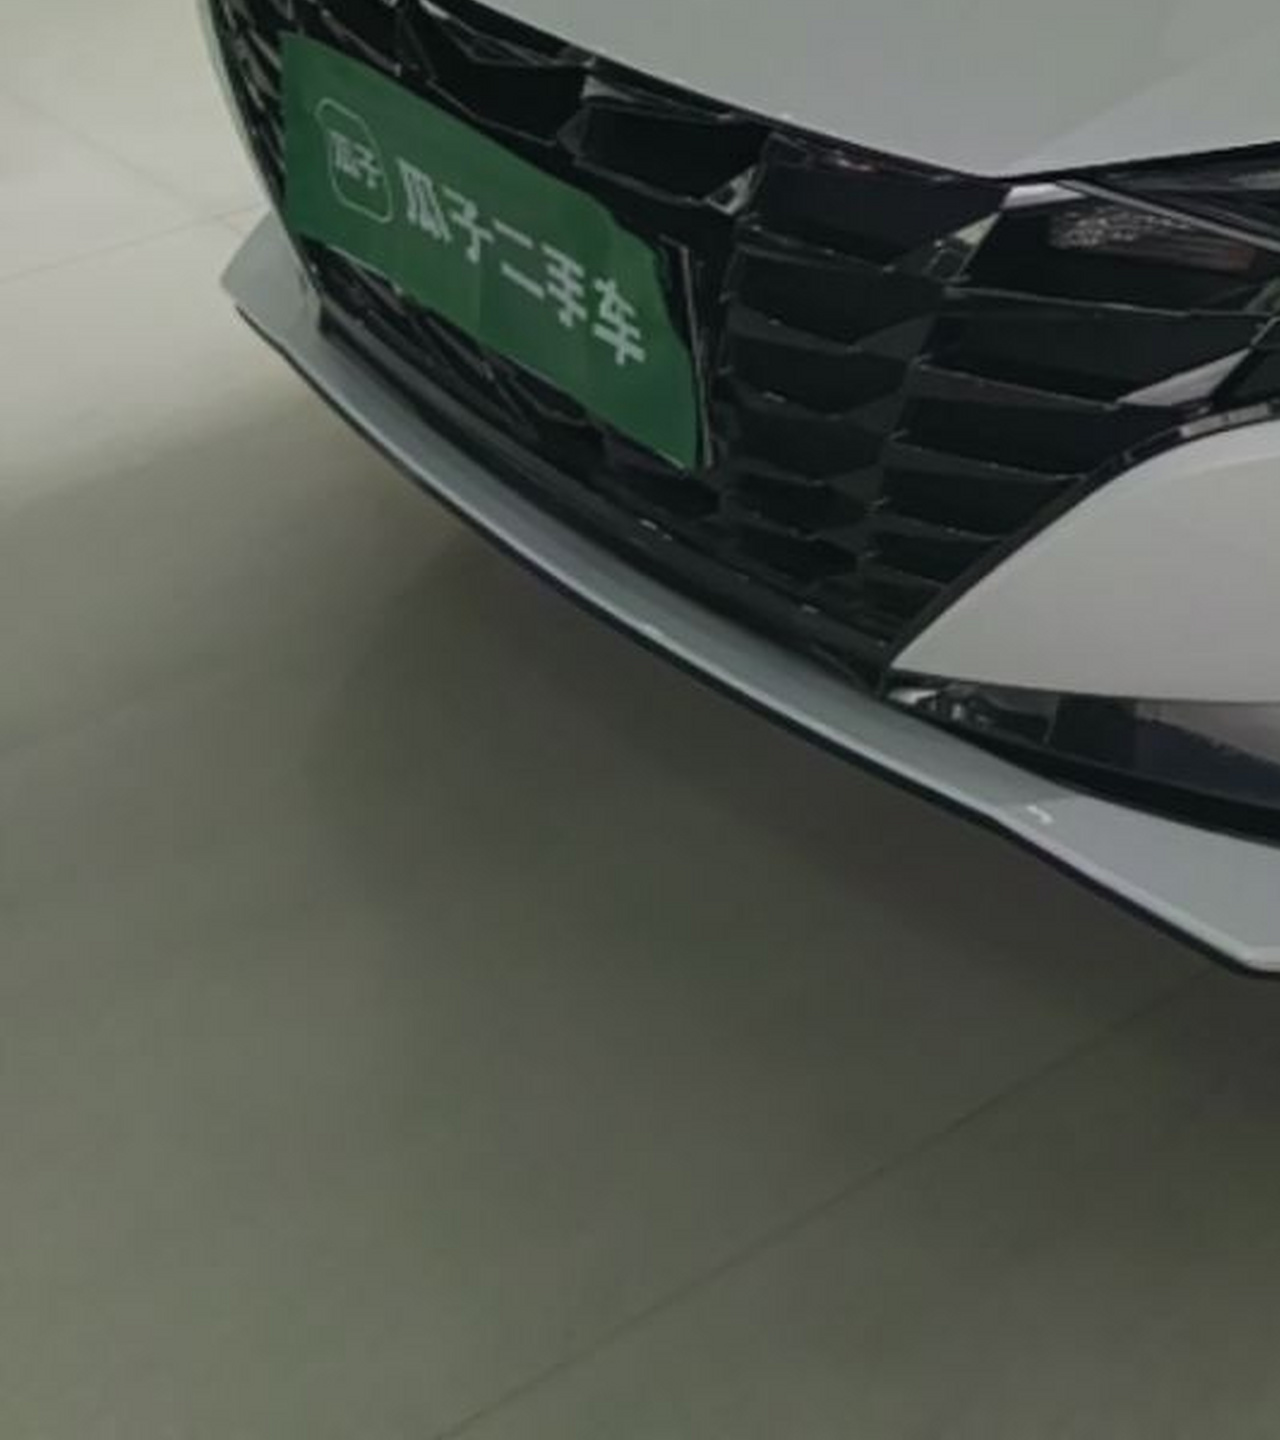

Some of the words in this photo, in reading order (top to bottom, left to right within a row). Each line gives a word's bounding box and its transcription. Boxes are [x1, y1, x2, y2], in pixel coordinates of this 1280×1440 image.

[396, 155, 646, 366] 瓜子二手车
